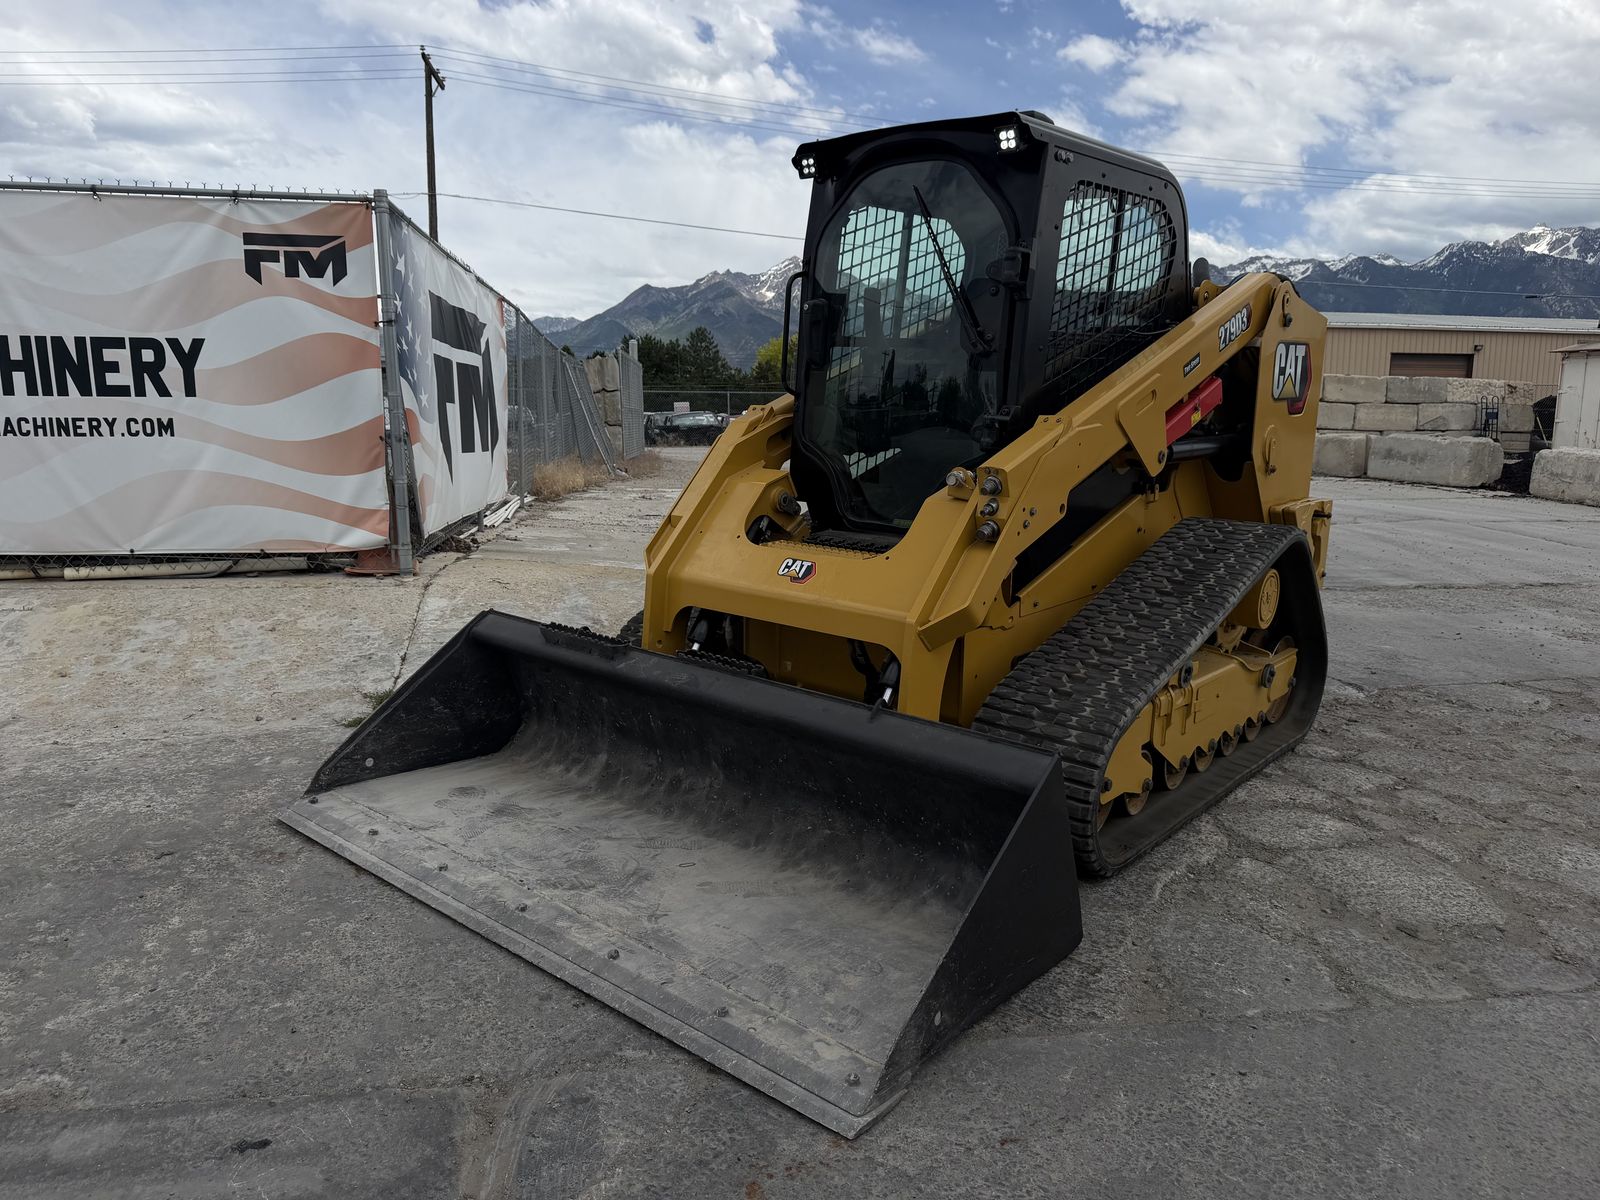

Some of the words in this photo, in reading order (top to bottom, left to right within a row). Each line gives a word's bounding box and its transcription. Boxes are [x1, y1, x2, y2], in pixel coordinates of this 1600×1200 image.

[243, 232, 347, 287] FM
[1219, 307, 1248, 348] 279D3
[0, 335, 205, 397] HINERY
[428, 290, 499, 485] FM
[1274, 343, 1306, 399] CAT
[0, 416, 175, 437] ACHINERY.COM
[778, 558, 812, 578] CAT
